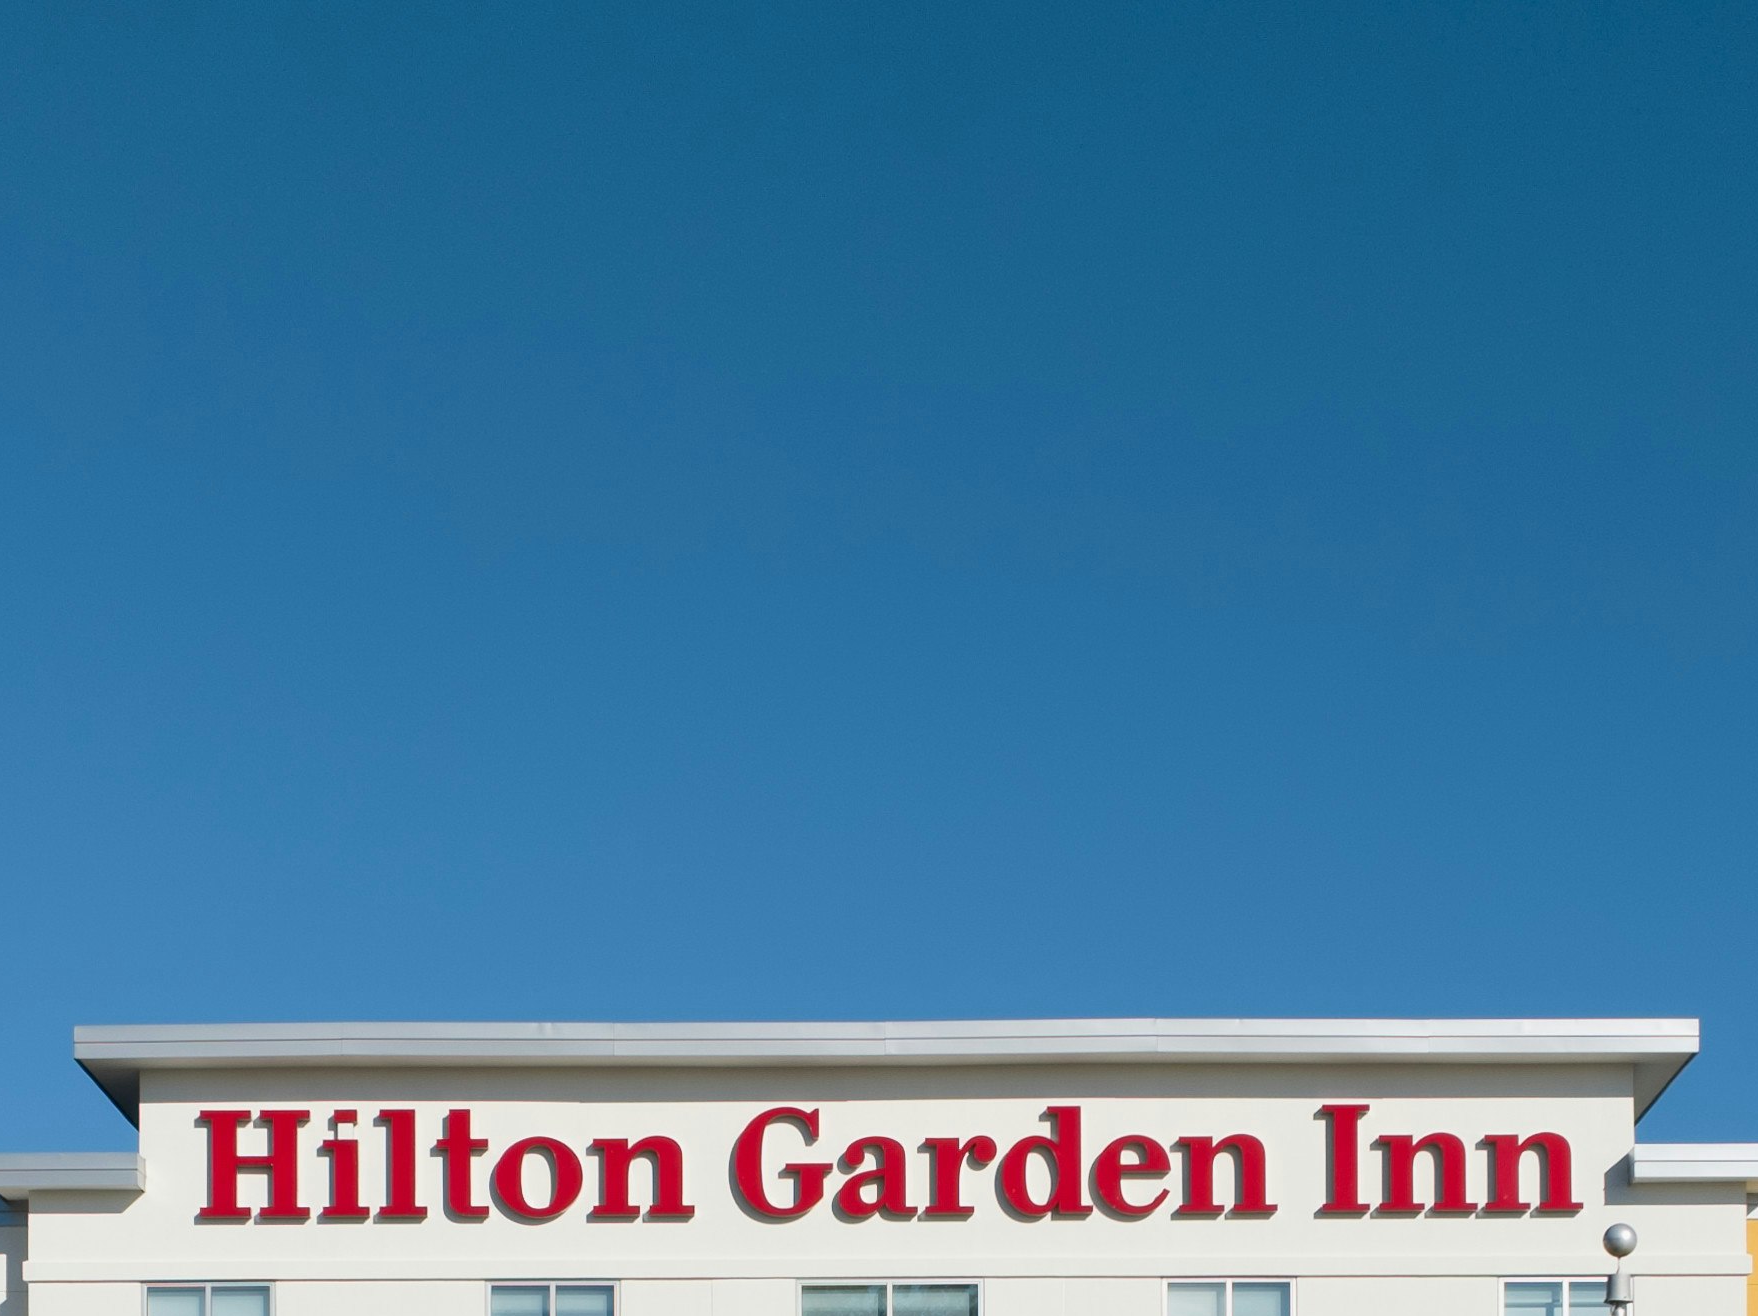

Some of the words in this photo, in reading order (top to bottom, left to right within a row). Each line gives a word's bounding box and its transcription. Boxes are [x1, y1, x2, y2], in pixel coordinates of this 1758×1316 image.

[197, 1106, 695, 1219] Hilton
[732, 1105, 1277, 1218] Garden
[1319, 1103, 1583, 1213] Inn
